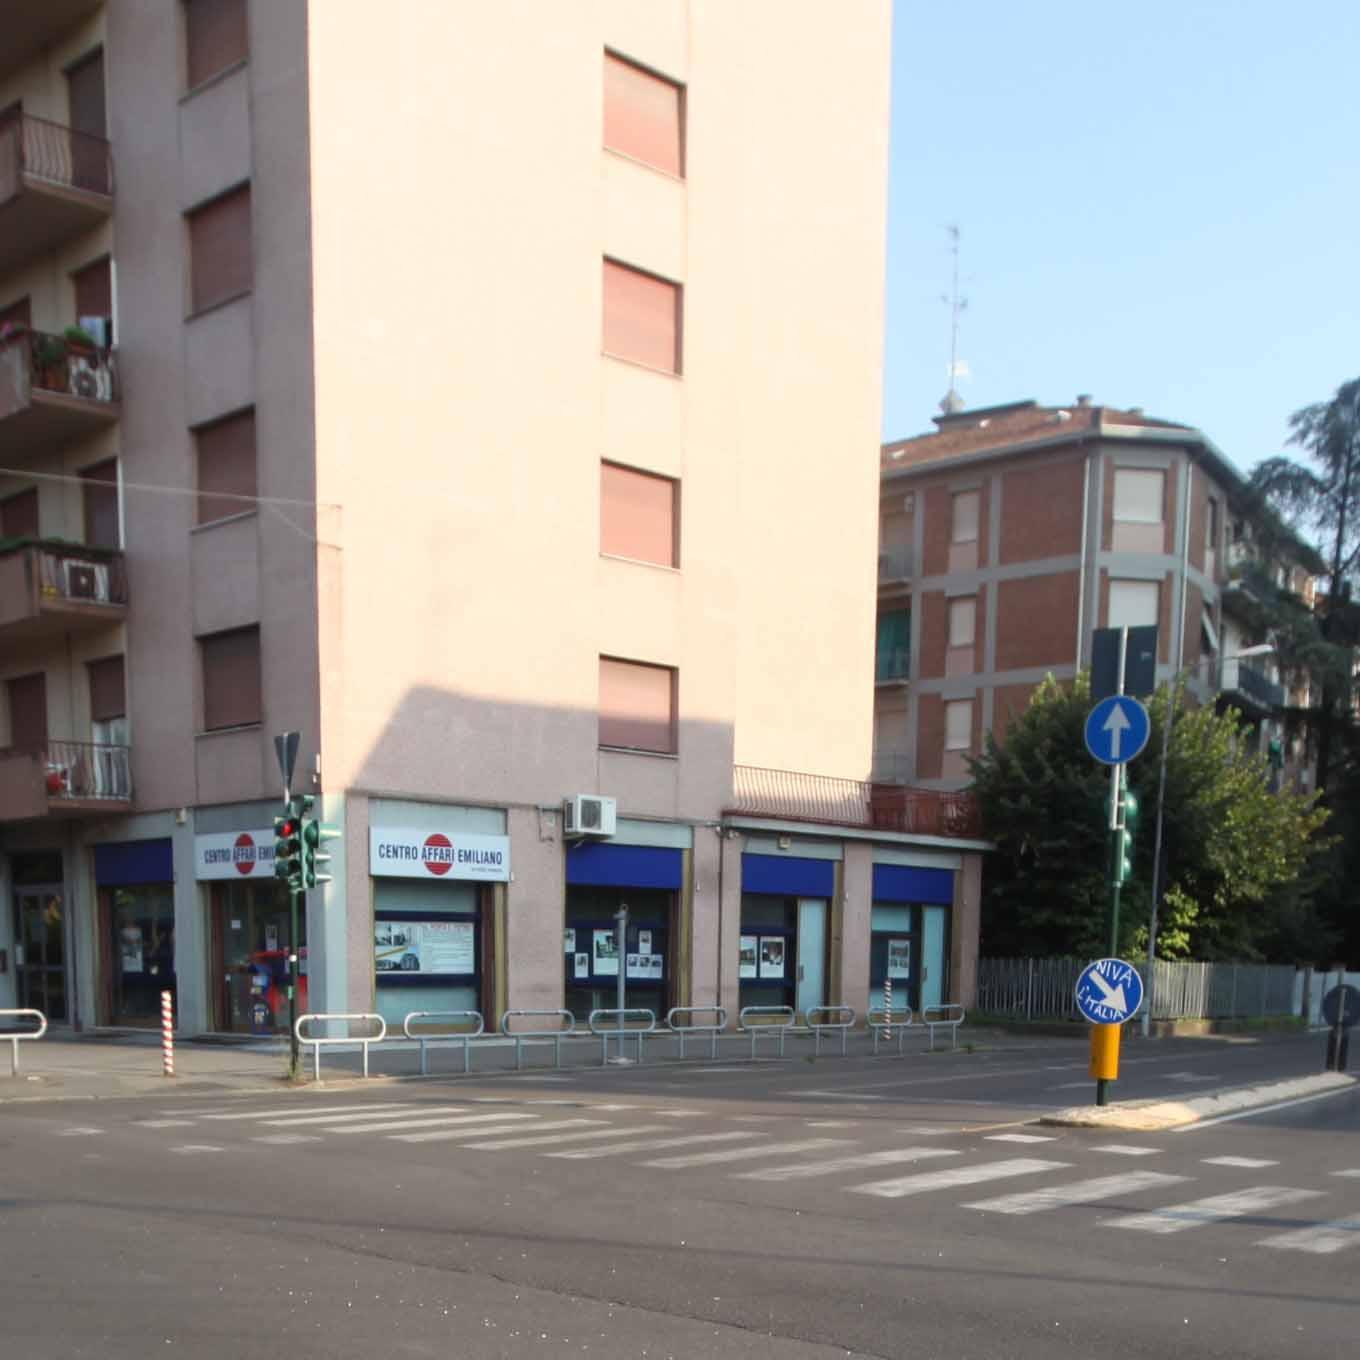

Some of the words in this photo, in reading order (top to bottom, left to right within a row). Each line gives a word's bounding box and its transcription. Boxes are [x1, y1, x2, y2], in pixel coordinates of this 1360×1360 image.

[203, 848, 232, 864] CENTRO
[232, 847, 257, 862] AFFARI
[378, 844, 418, 861] CENTRO
[421, 847, 455, 863] AFFARI
[458, 849, 503, 865] EMILIANO
